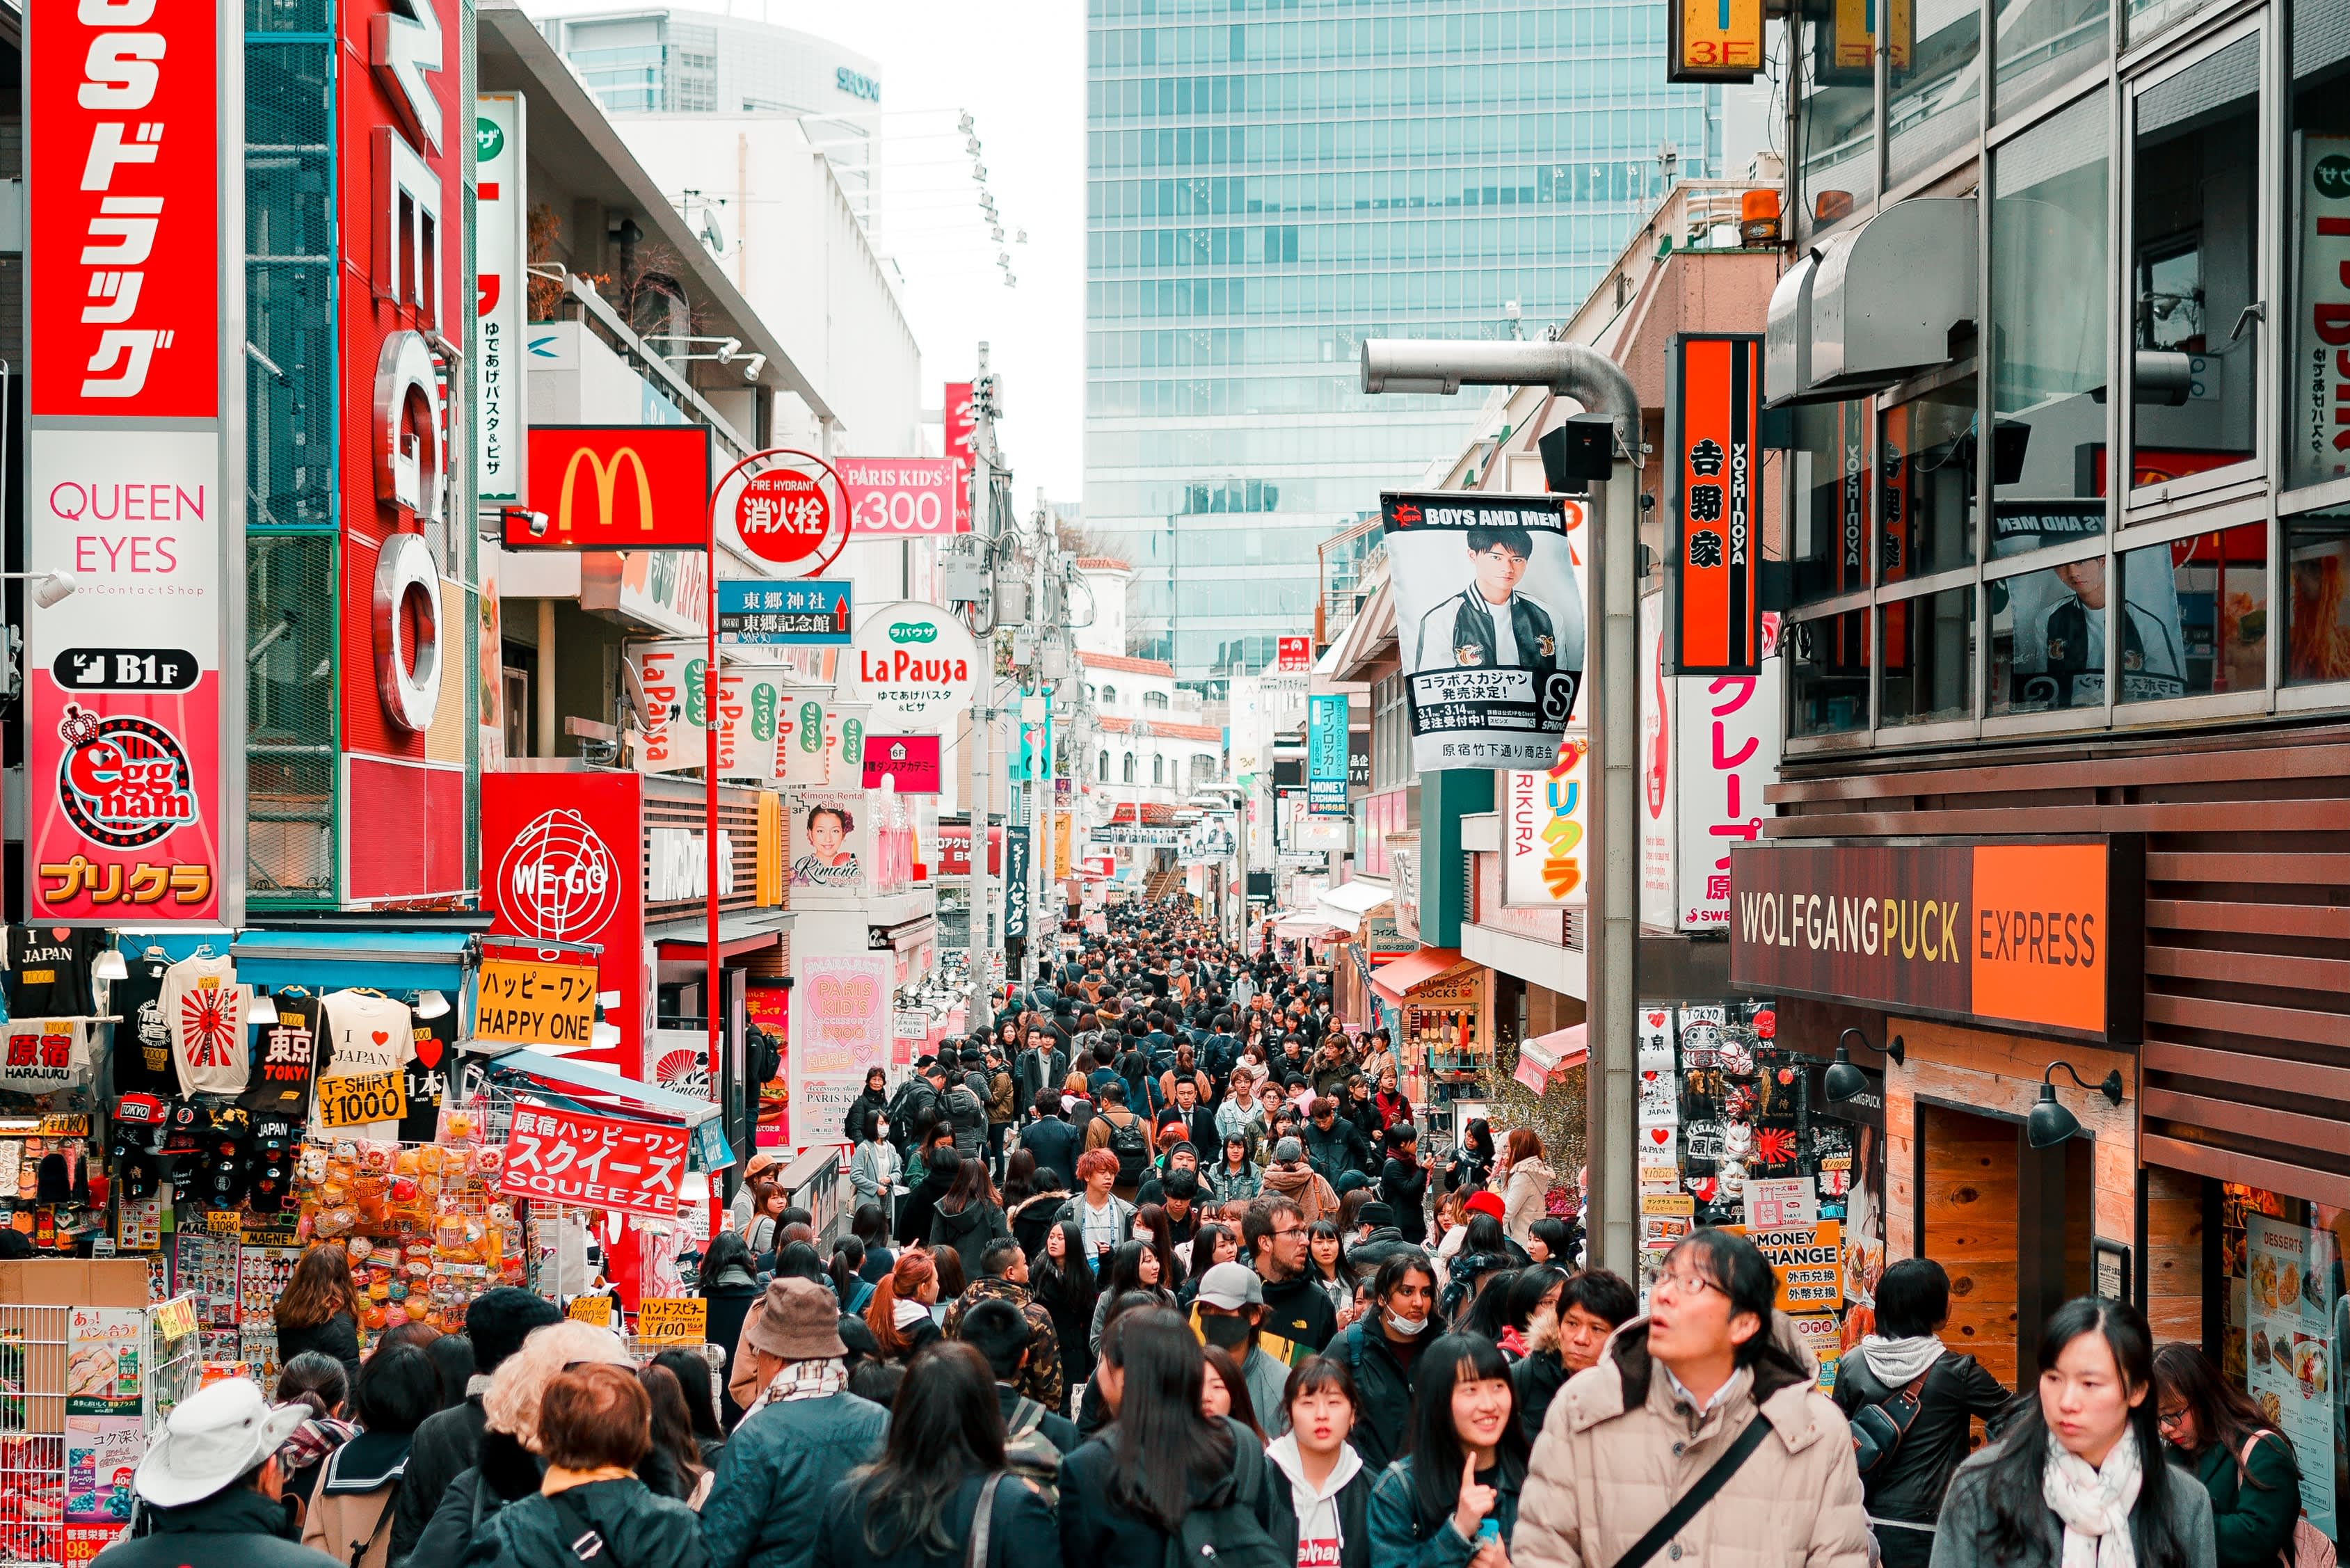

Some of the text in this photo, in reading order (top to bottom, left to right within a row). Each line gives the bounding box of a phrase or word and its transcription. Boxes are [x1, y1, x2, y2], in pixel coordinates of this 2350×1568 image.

[1690, 41, 1754, 65] 3F
[751, 479, 815, 491] FIRE HYDRANT
[848, 467, 943, 486] PARIS KID'S
[49, 481, 205, 521] QUEEN
[1688, 438, 1725, 569] 吉野家
[1730, 442, 1747, 566] YOSHINOYA
[744, 497, 824, 535] 消火栓
[852, 491, 942, 530] ¥300
[1425, 508, 1560, 529] BOYS AND MEN
[77, 536, 177, 573] EYES
[77, 584, 205, 597] orContactShop
[742, 591, 826, 610] 東郷神社
[742, 614, 831, 633] 東郷記念館
[890, 627, 936, 638] ラパウザ
[115, 653, 179, 685] B1F
[861, 650, 968, 685] La Pausa
[1420, 672, 1528, 690] コラボスカジャン
[877, 690, 952, 701] ゆであげパスタ
[1442, 686, 1508, 701] 発売決定!
[642, 653, 677, 761] La Pausa
[1419, 714, 1485, 731] 受注受付中!
[718, 706, 743, 769] Pausa
[893, 749, 904, 758] 6F
[1442, 743, 1553, 759] 原宿竹下通り商店会
[70, 742, 173, 797] egg
[801, 792, 865, 800] Kimono Rental
[1311, 781, 1345, 793] MONEY
[822, 801, 845, 810] Shop
[1311, 794, 1345, 804] EXCHANGE
[1515, 774, 1533, 857] RIKURA
[1541, 739, 1588, 900] プリクラ
[795, 853, 861, 885] Kimono
[28, 929, 37, 945] I
[1740, 890, 2095, 968] WOLFGANG PUCK EXPRESS
[22, 947, 72, 963] JAPAN
[482, 971, 593, 1004] ハッピーワン
[817, 979, 872, 998] PARIS
[1419, 989, 1457, 998] SOCKS
[821, 998, 869, 1016] KID'S
[1686, 1009, 1720, 1020] TOKYO
[479, 1007, 590, 1041] HAPPY ONE
[265, 1026, 313, 1064] 東京
[344, 1029, 352, 1043] I
[6, 1034, 72, 1068] 原宿
[335, 1048, 391, 1067] JAPAN
[5, 1068, 70, 1080] HARAJUKU
[322, 1073, 394, 1095] T-SHIRT
[807, 1084, 859, 1093] Accessory shop
[322, 1088, 399, 1126] ¥1000
[807, 1094, 840, 1103] PARIS
[122, 1104, 148, 1118] TOKYO
[258, 1122, 287, 1137] JAPAN
[514, 1112, 684, 1155] 原宿ハッピーワン
[1690, 1139, 1723, 1155] 原宿
[1825, 1151, 1849, 1160] JAPAN
[509, 1135, 682, 1194] スクイーズ
[1643, 1169, 1672, 1178] ¥1000
[1824, 1160, 1851, 1169] ¥1000
[504, 1171, 675, 1211] SQUEEZE
[210, 1219, 238, 1232] ¥1080
[1757, 1231, 1816, 1246] MONEY
[2263, 1231, 2303, 1253] DESSERTS
[1764, 1247, 1837, 1265] HANGE
[1787, 1270, 1835, 1283] 外币兑换
[93, 1429, 139, 1447] コク深く
[66, 1529, 119, 1541] 管理栄養士
